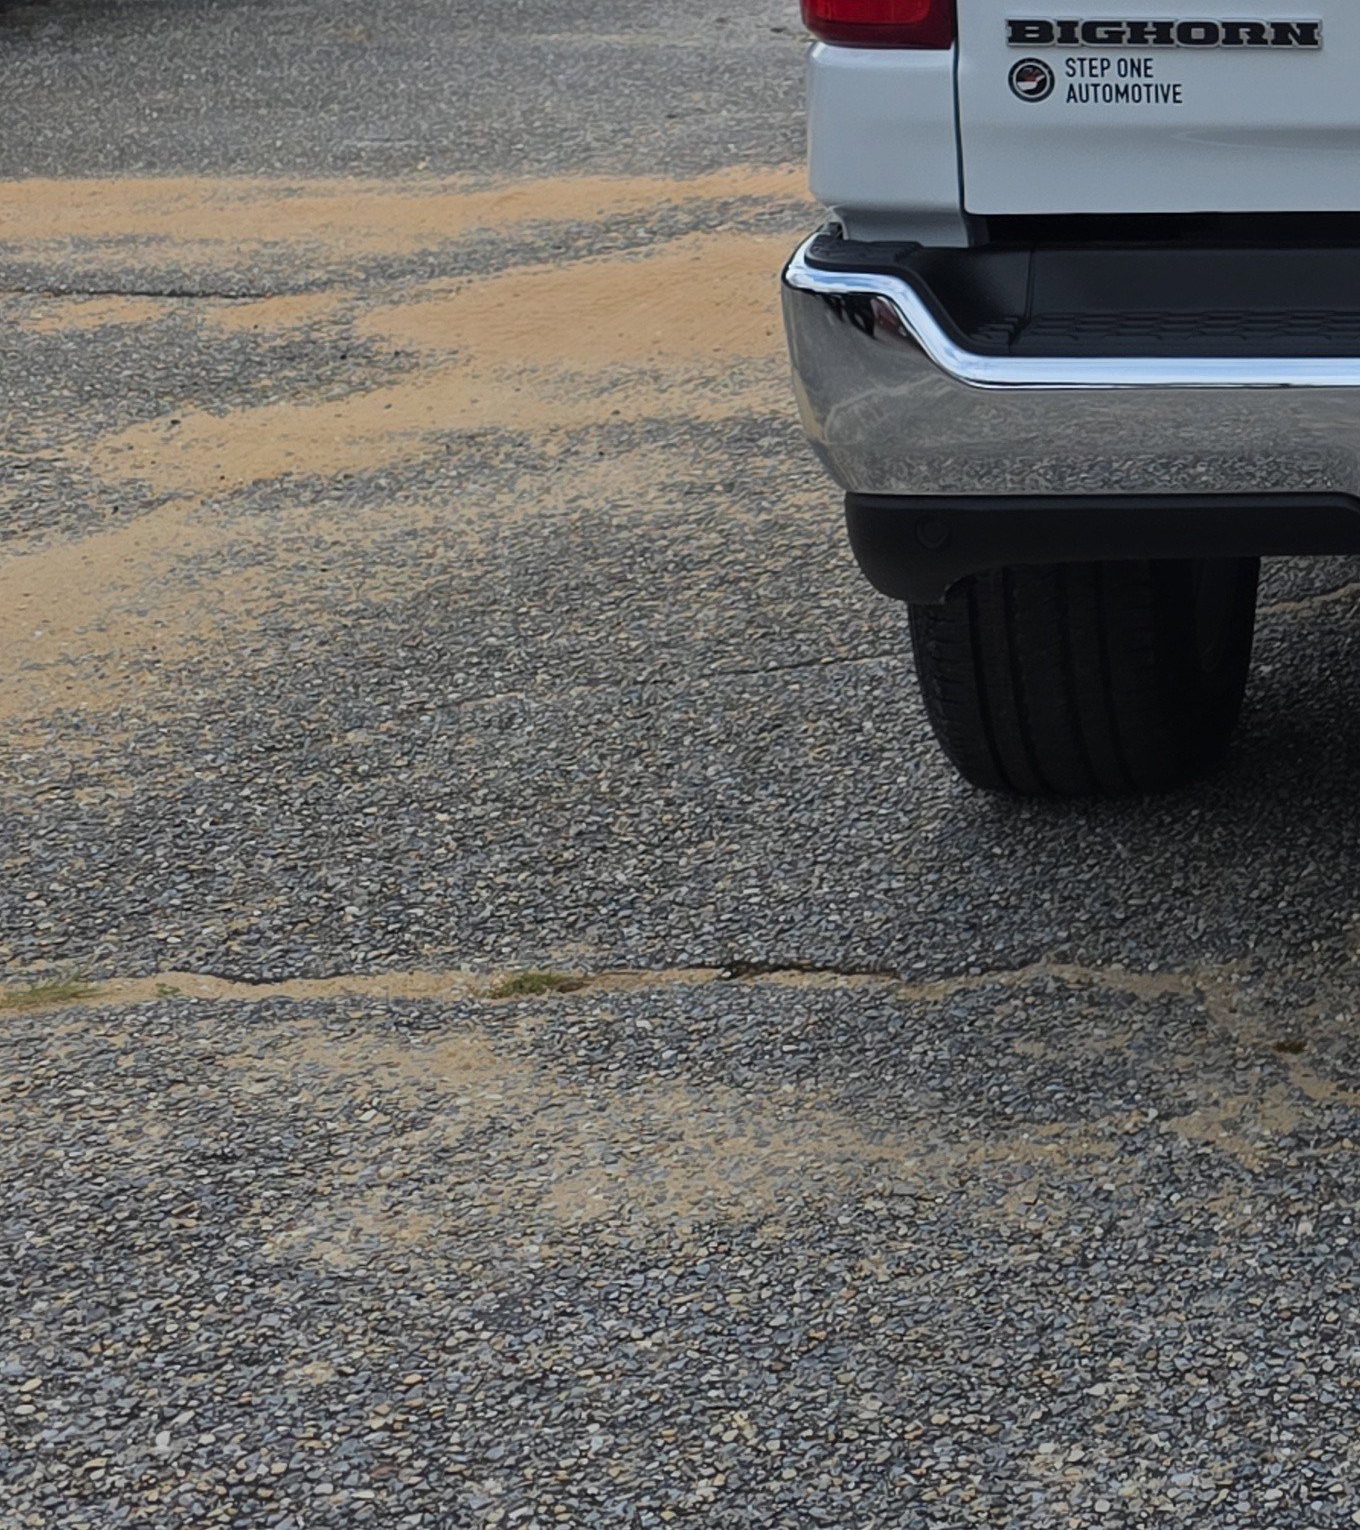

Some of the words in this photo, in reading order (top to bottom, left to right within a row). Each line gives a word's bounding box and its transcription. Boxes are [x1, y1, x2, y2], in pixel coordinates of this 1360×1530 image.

[1006, 19, 1322, 49] BIGHORN
[1065, 57, 1111, 78] STEP
[1117, 57, 1154, 78] ONE
[1065, 83, 1183, 104] AUTOMOTIVE
